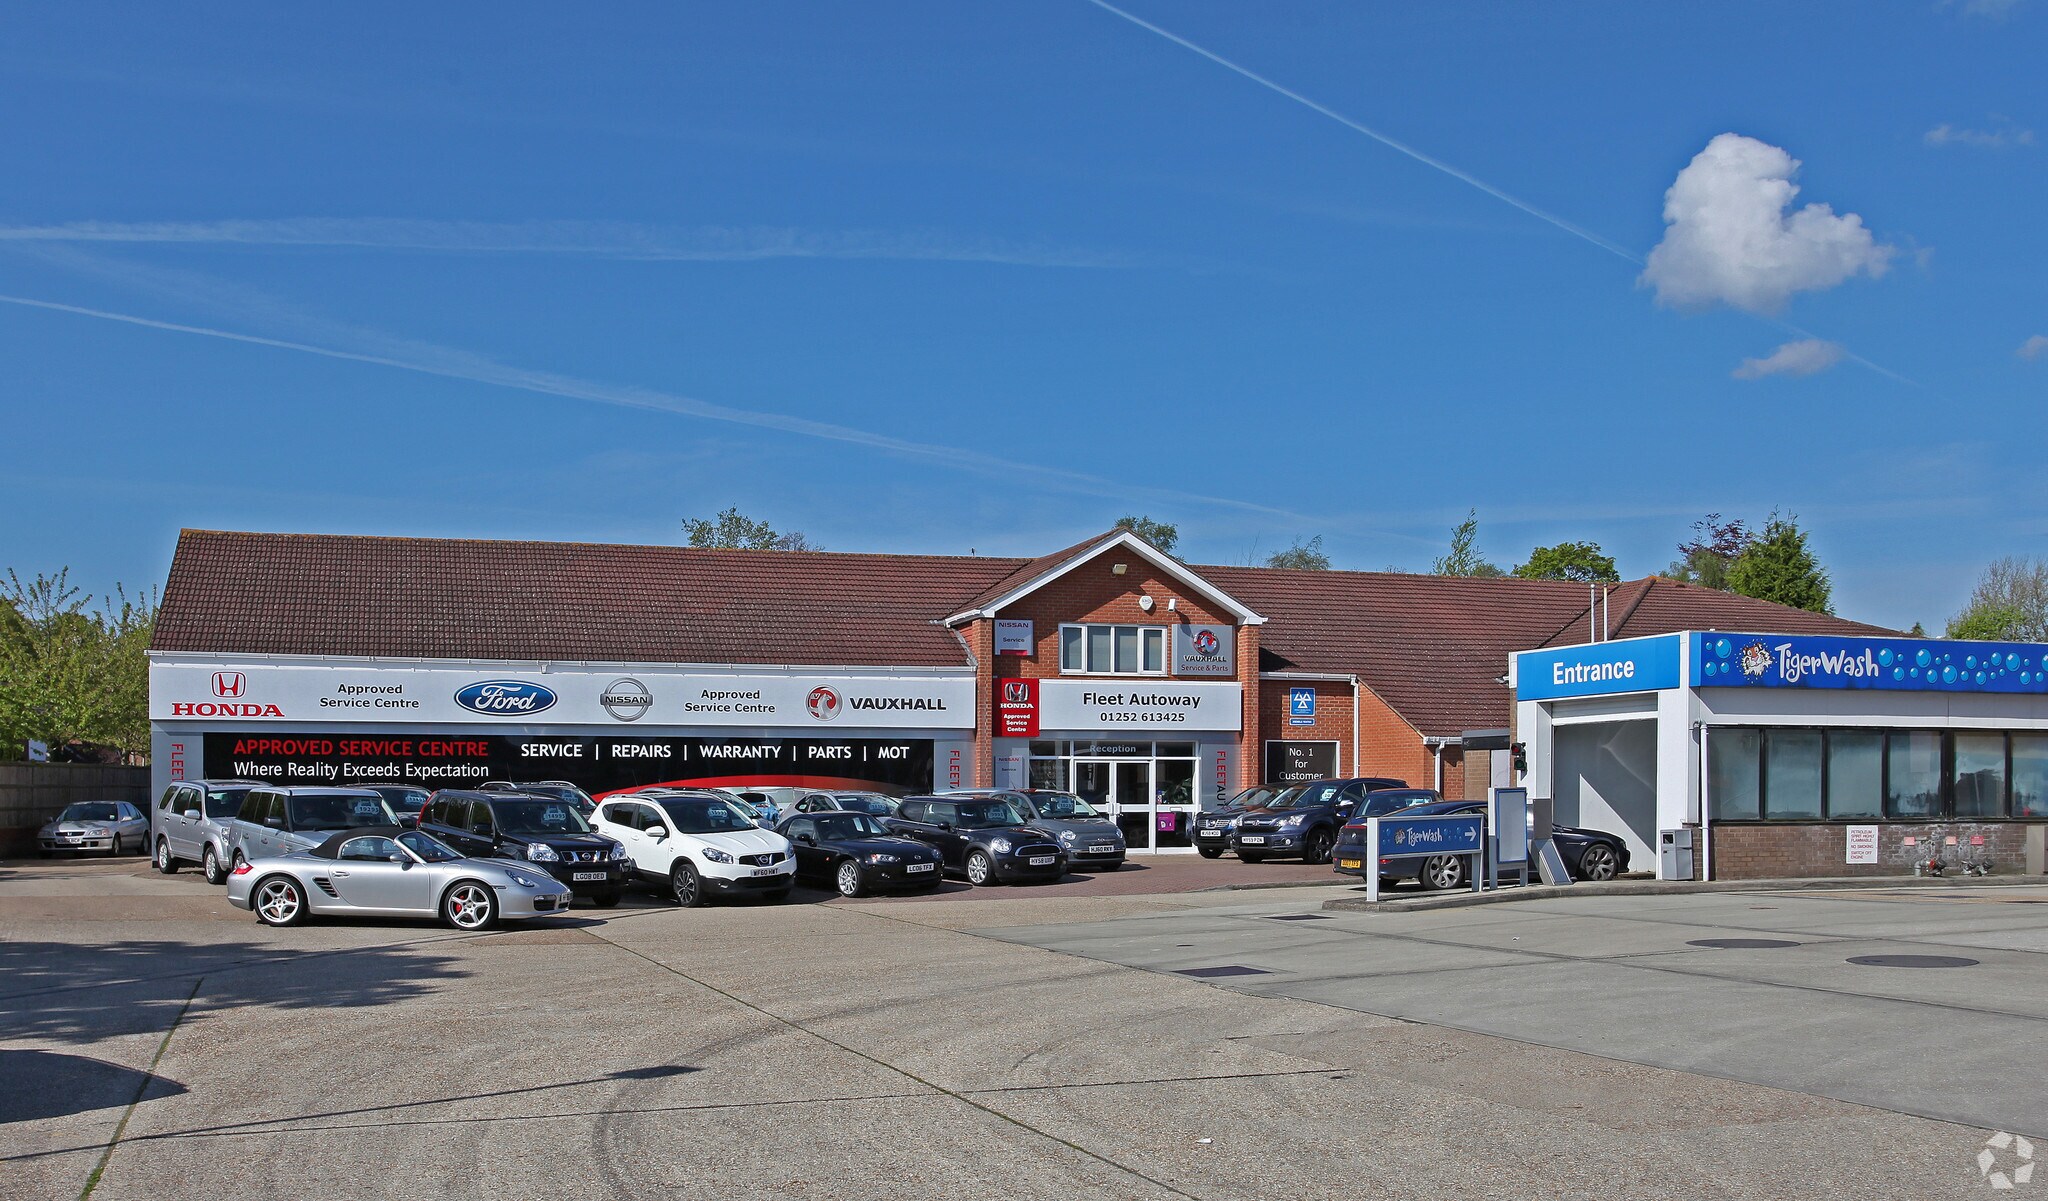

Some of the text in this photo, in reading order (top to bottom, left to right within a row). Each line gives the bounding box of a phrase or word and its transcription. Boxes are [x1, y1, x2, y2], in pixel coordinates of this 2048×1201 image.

[1184, 655, 1227, 663] VAUXHALL
[1774, 643, 1879, 683] TigerWash
[1553, 660, 1635, 685] Entrance
[338, 684, 403, 696] Approved
[701, 689, 760, 702] Approved
[320, 697, 420, 708] Service Centre
[474, 684, 536, 710] Ford
[605, 696, 648, 704] NISSAN
[850, 697, 947, 710] VAUXHALL
[1083, 692, 1201, 709] Fleet Autoway
[171, 703, 285, 717] HONDA
[684, 702, 776, 713] Service Centre
[1100, 712, 1185, 722] 01252 613425
[233, 739, 488, 757] APPROVED SERVICE CENTRE
[521, 743, 910, 759] SERVICE REPAIRS WARRANTY PARTS MOT
[1089, 744, 1137, 753] Reception
[1289, 748, 1314, 757] No. 1
[1294, 759, 1308, 768] for
[234, 761, 489, 780] Where Reality Exceeds Expectation
[1278, 771, 1324, 780] Customer
[1406, 827, 1443, 847] TigerWash
